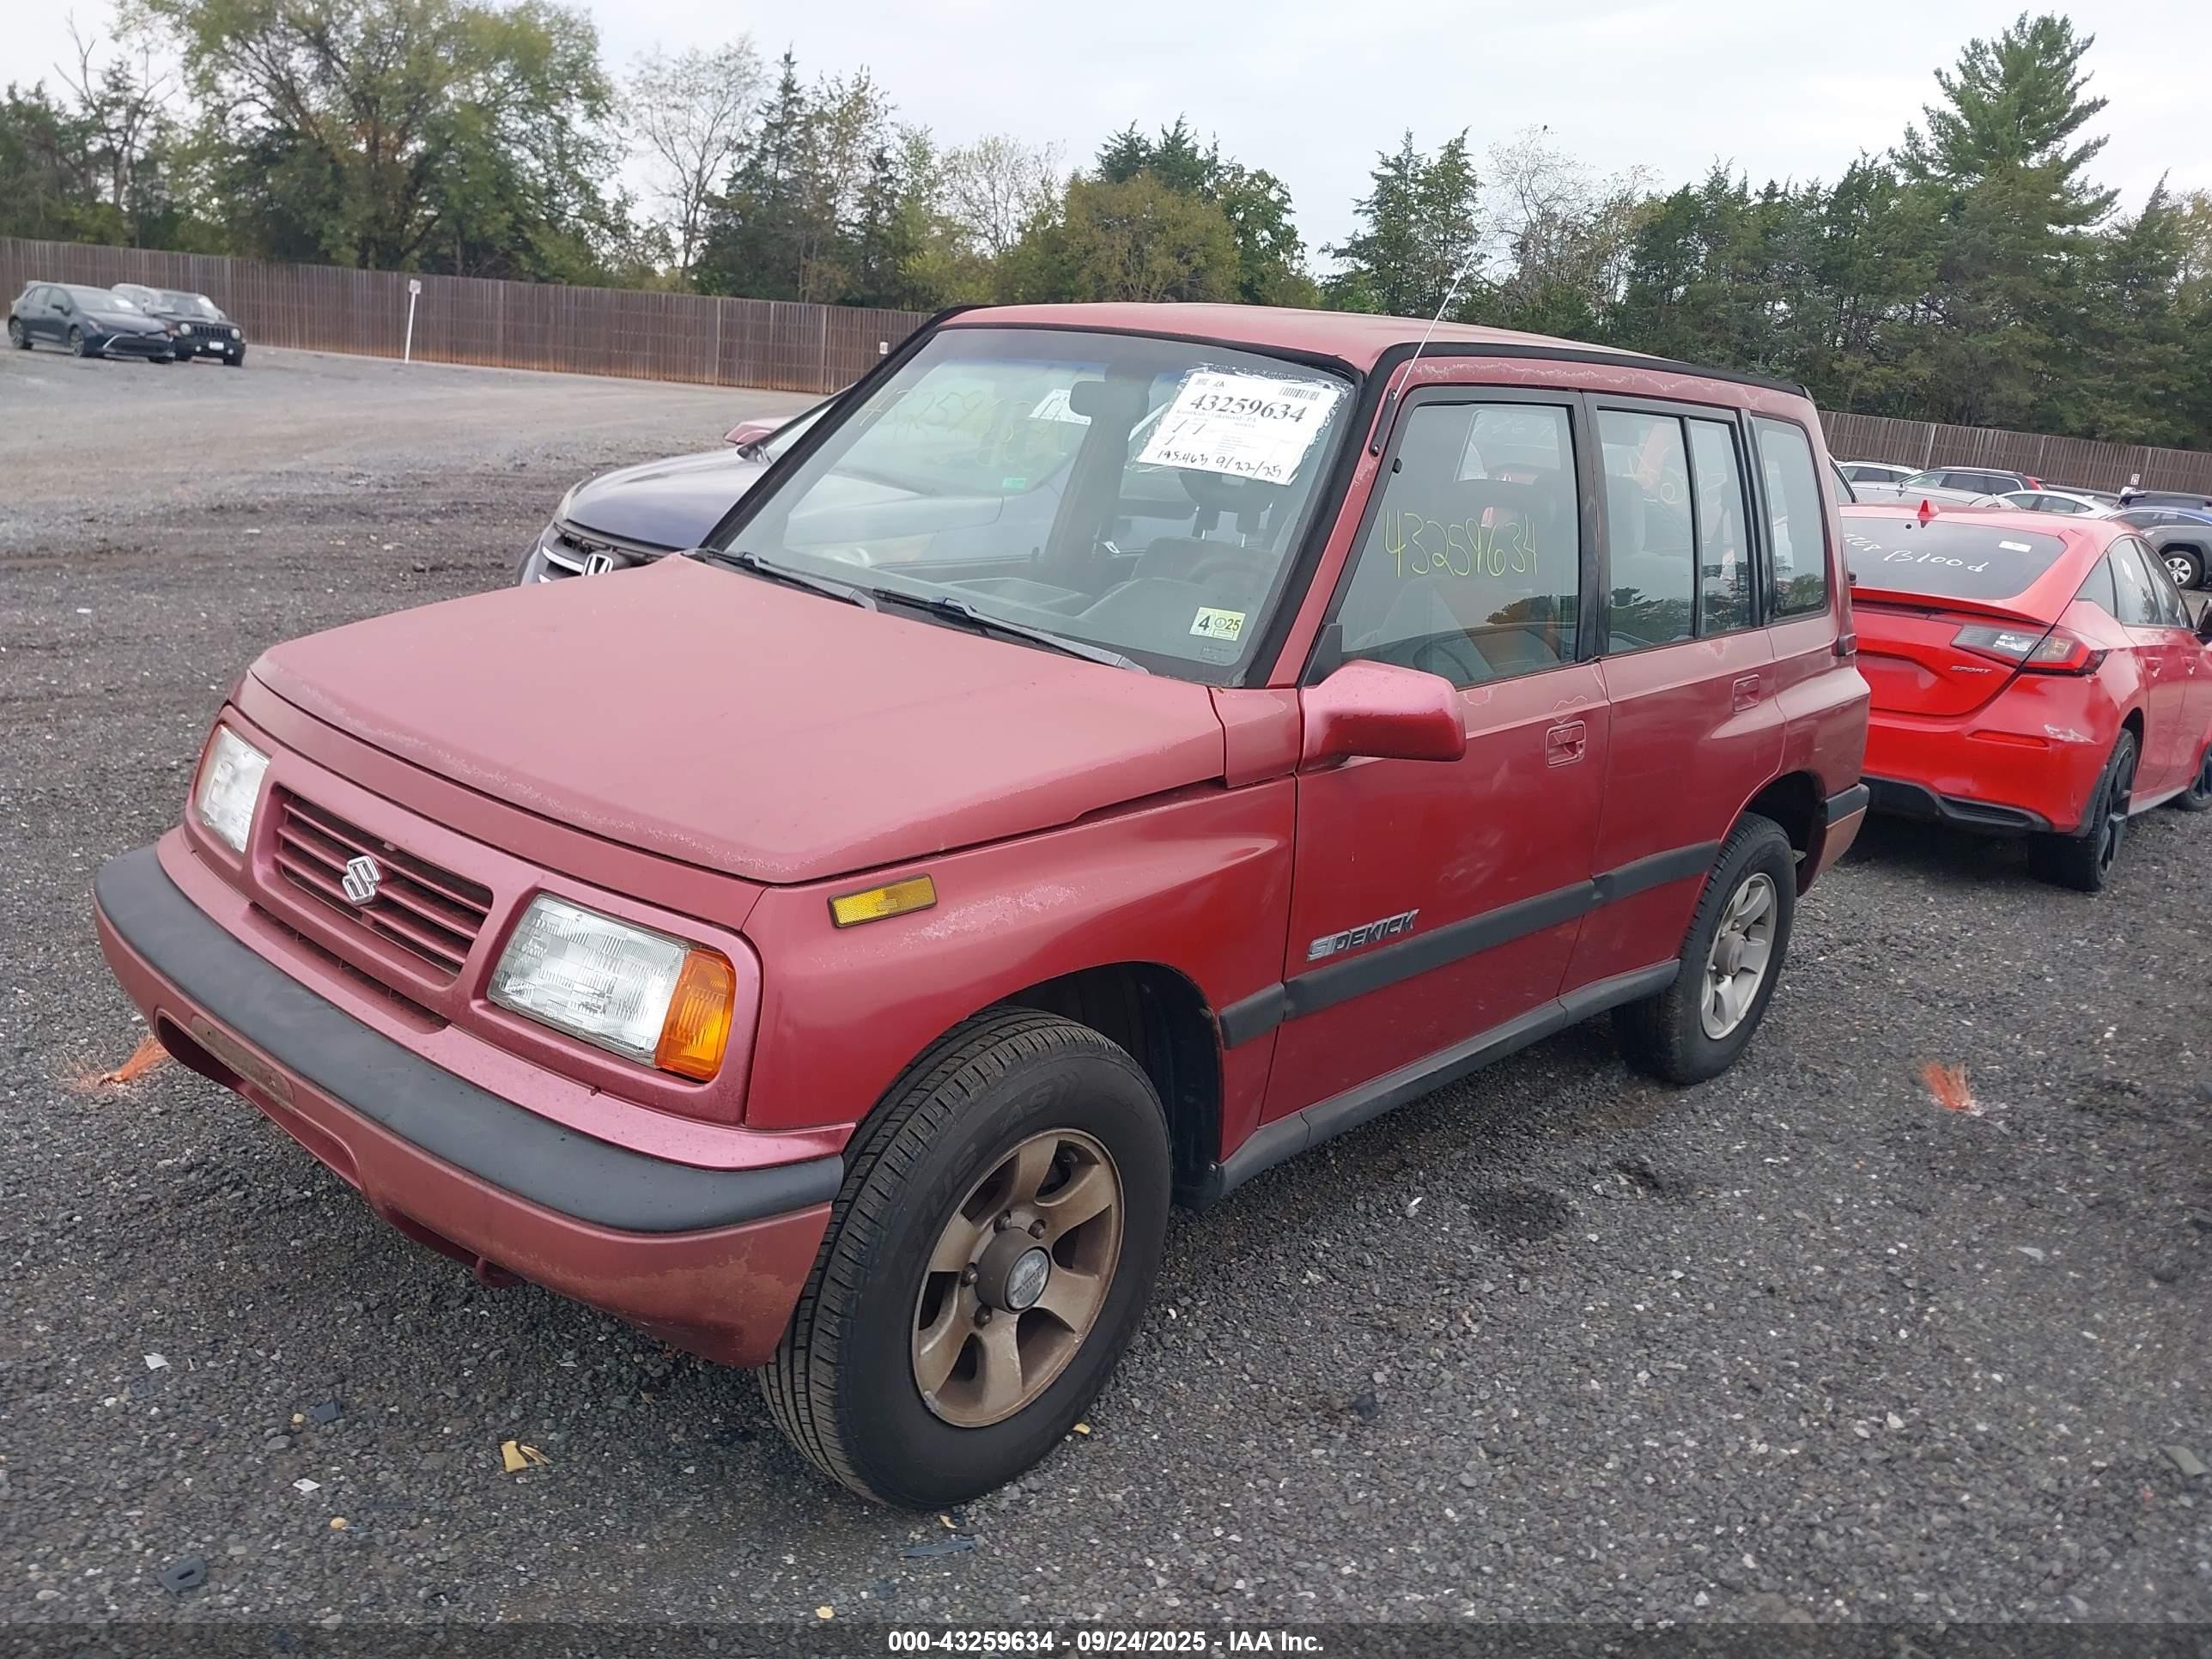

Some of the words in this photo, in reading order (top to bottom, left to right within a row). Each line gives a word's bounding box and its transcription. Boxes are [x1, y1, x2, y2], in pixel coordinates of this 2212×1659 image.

[1190, 393, 1307, 423] 43259634
[1384, 508, 1538, 577] 43259634
[1198, 615, 1211, 631] 4
[1224, 618, 1242, 631] 25
[1306, 908, 1420, 962] SIDEKICK
